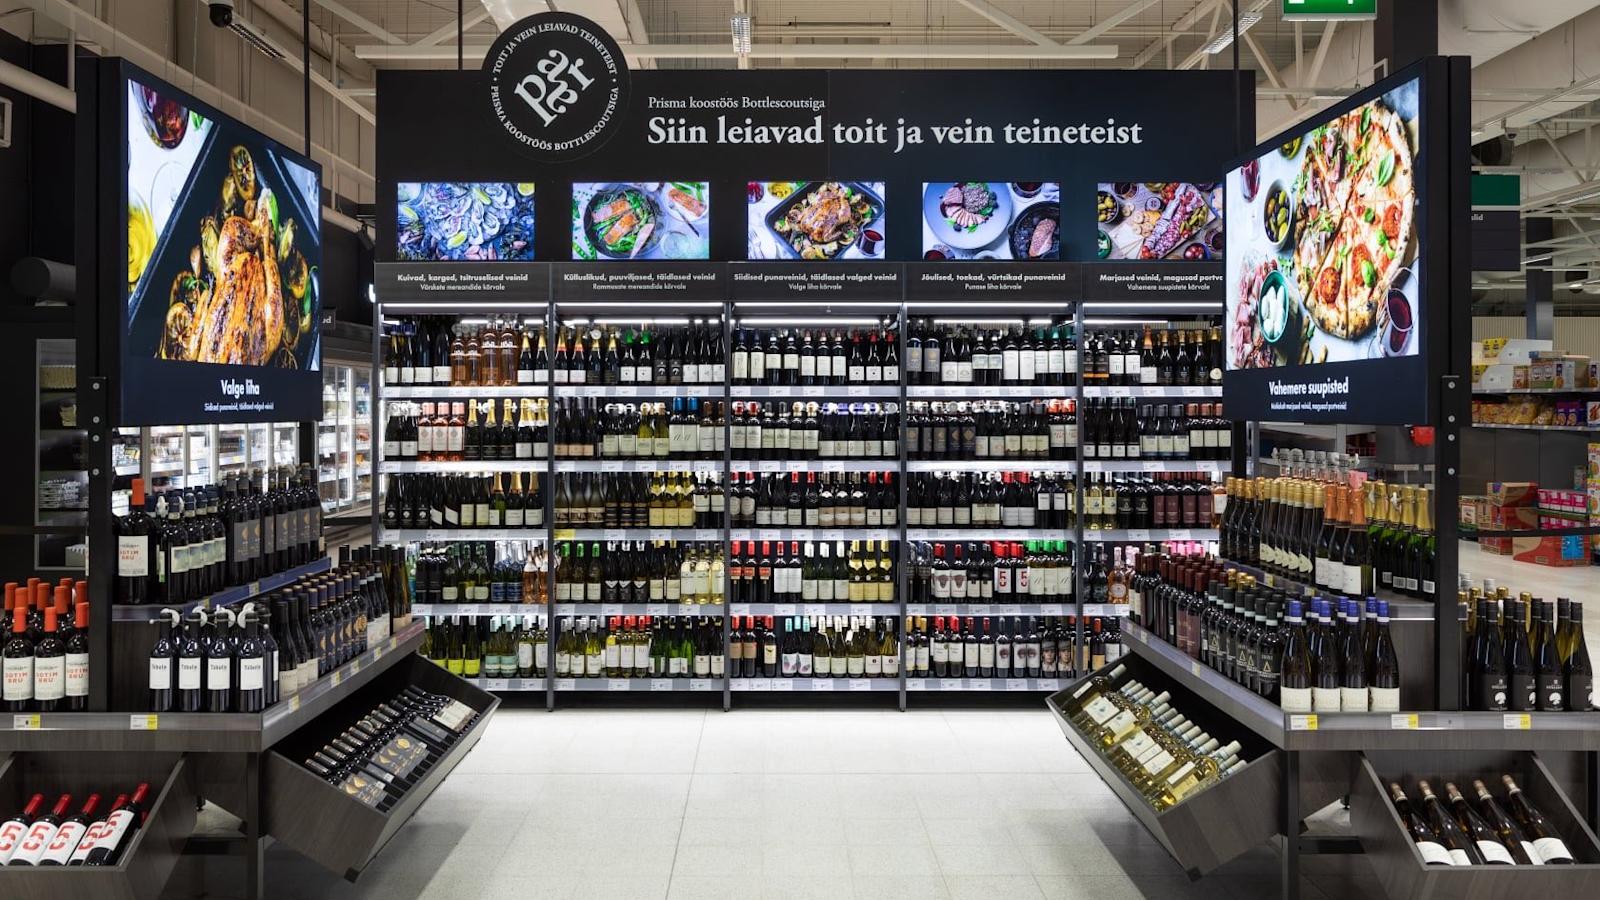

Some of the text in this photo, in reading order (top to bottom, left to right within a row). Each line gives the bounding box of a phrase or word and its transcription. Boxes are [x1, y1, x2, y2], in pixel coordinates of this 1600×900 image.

[492, 22, 618, 75] TOIT JA VEIN LEIAVAD TEINETEIST
[648, 96, 825, 112] Prisma koostöös Bottlescoutsiga
[490, 85, 619, 151] PRISMA KOOSTÖÖS BOTTLESCOUTSIGA
[648, 114, 1143, 154] Siin leiavad toit ja vein teineteist
[873, 273, 897, 281] veinid
[1024, 274, 1066, 282] punaveinid
[220, 378, 260, 400] Valge liha
[1268, 376, 1349, 399] Vahemere suupisted
[22, 825, 50, 850] 5
[49, 825, 75, 850] 5
